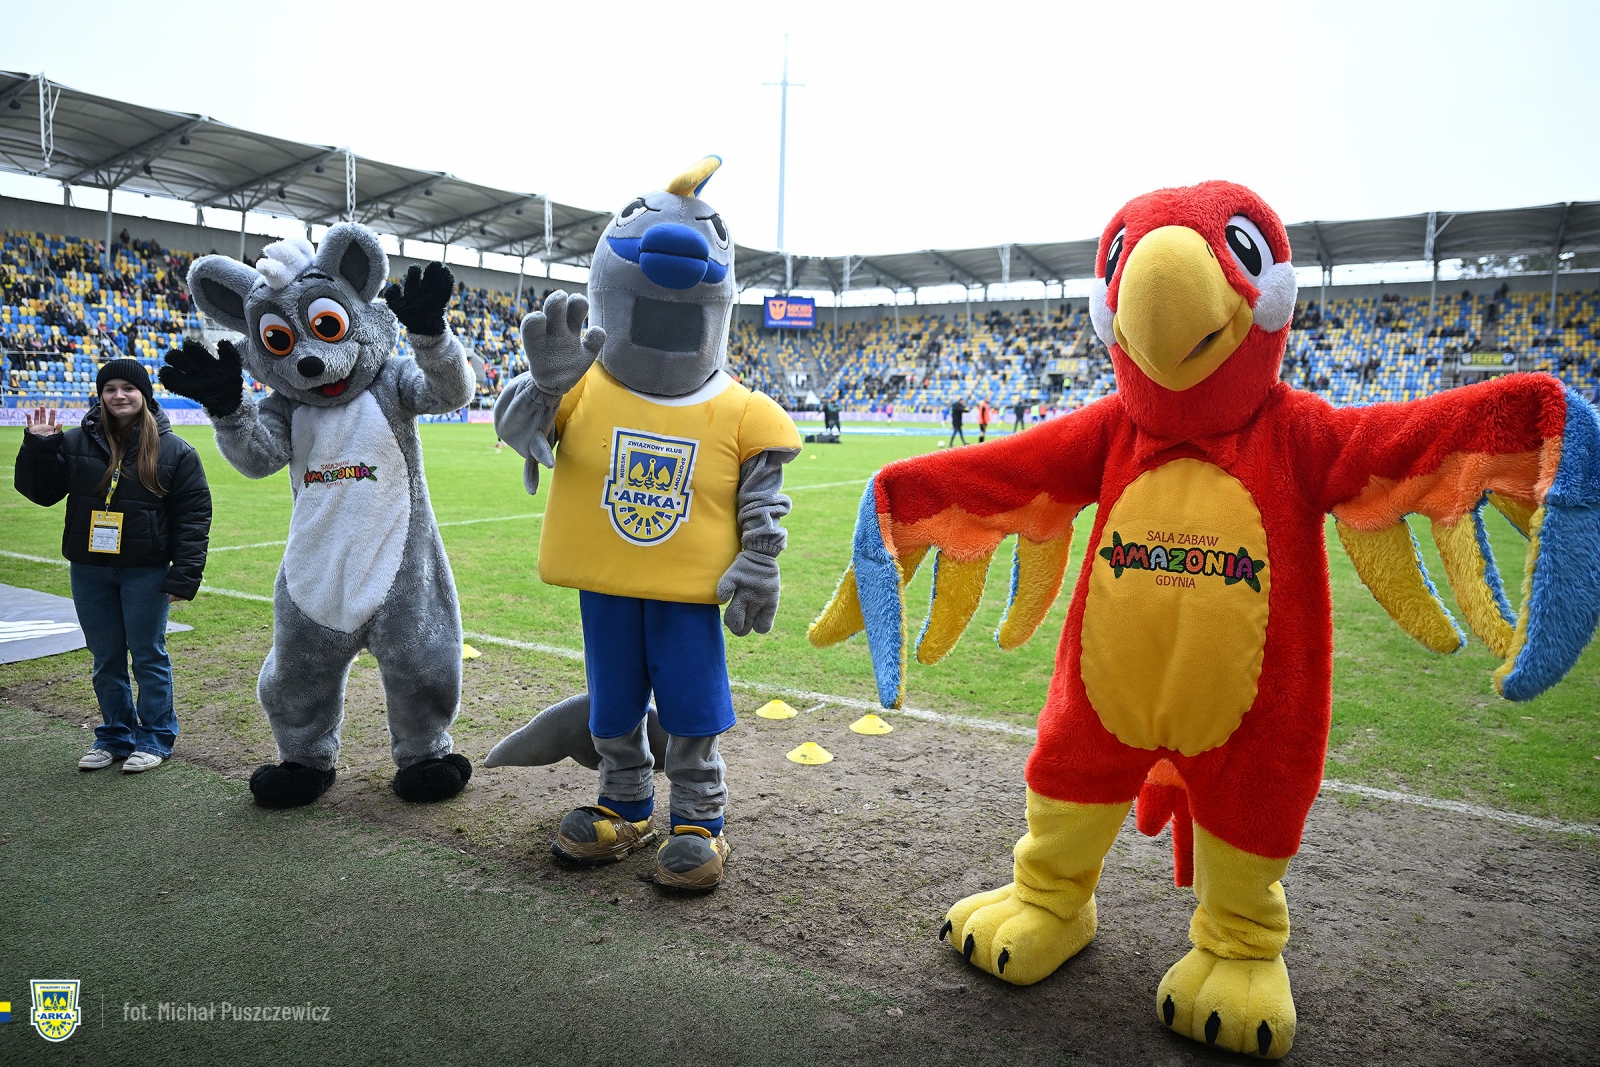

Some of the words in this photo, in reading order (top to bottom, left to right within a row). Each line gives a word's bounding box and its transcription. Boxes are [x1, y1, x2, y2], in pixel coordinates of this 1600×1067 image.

[627, 440, 665, 452] ZWIĄZKOWY
[304, 466, 371, 484] AMAZONIA
[619, 453, 627, 479] MORSKI
[673, 457, 686, 491] SPORTOWY
[617, 490, 675, 509] ARKA
[1146, 530, 1175, 544] SALA
[1177, 533, 1219, 547] ZABAW
[1109, 544, 1256, 580] AMAZONIA
[1155, 574, 1196, 589] GDYNIA
